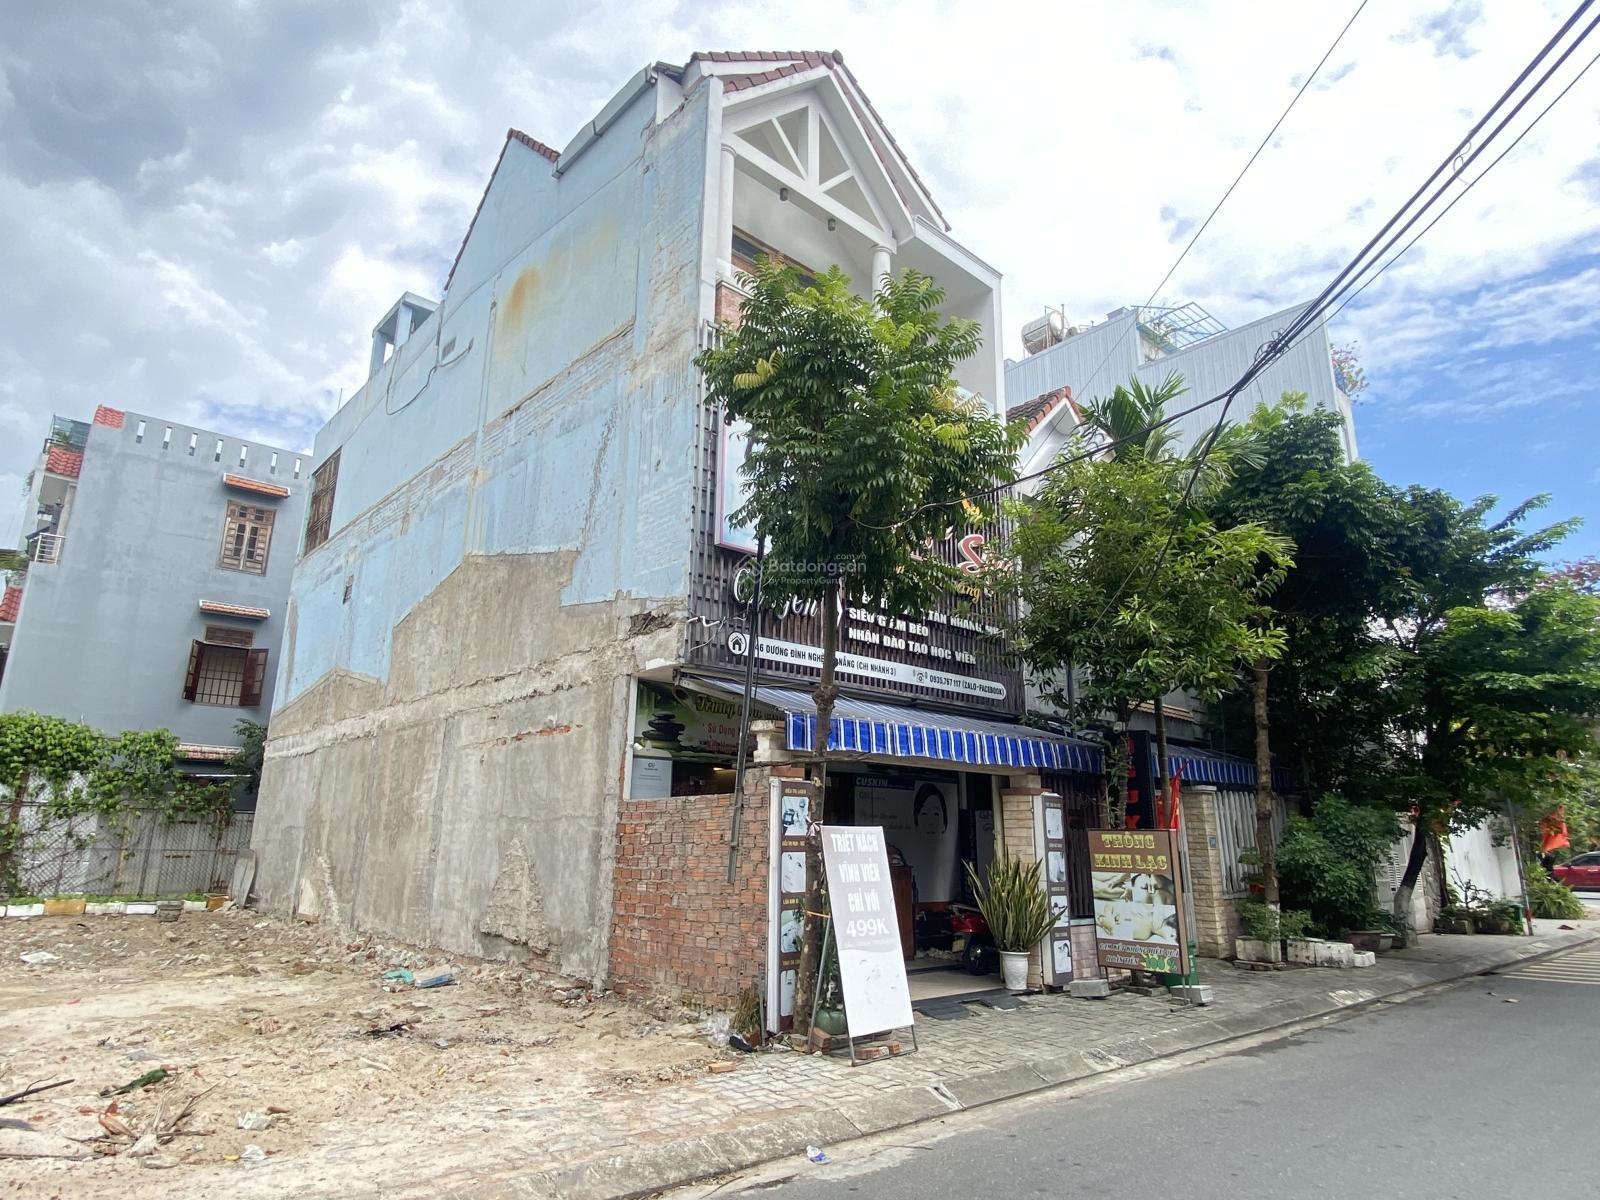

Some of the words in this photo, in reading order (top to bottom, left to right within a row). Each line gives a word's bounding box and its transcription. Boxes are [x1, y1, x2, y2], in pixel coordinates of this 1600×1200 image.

[848, 627, 880, 644] NHẬN
[882, 634, 906, 650] ĐÀO
[907, 640, 929, 655] TẠO
[954, 650, 977, 665] VIÊN
[855, 777, 889, 787] CUSKIN
[1101, 831, 1155, 849] THÔNG
[1094, 853, 1133, 868] KINH
[1134, 855, 1168, 872] LẠC
[846, 918, 890, 937] 499K
